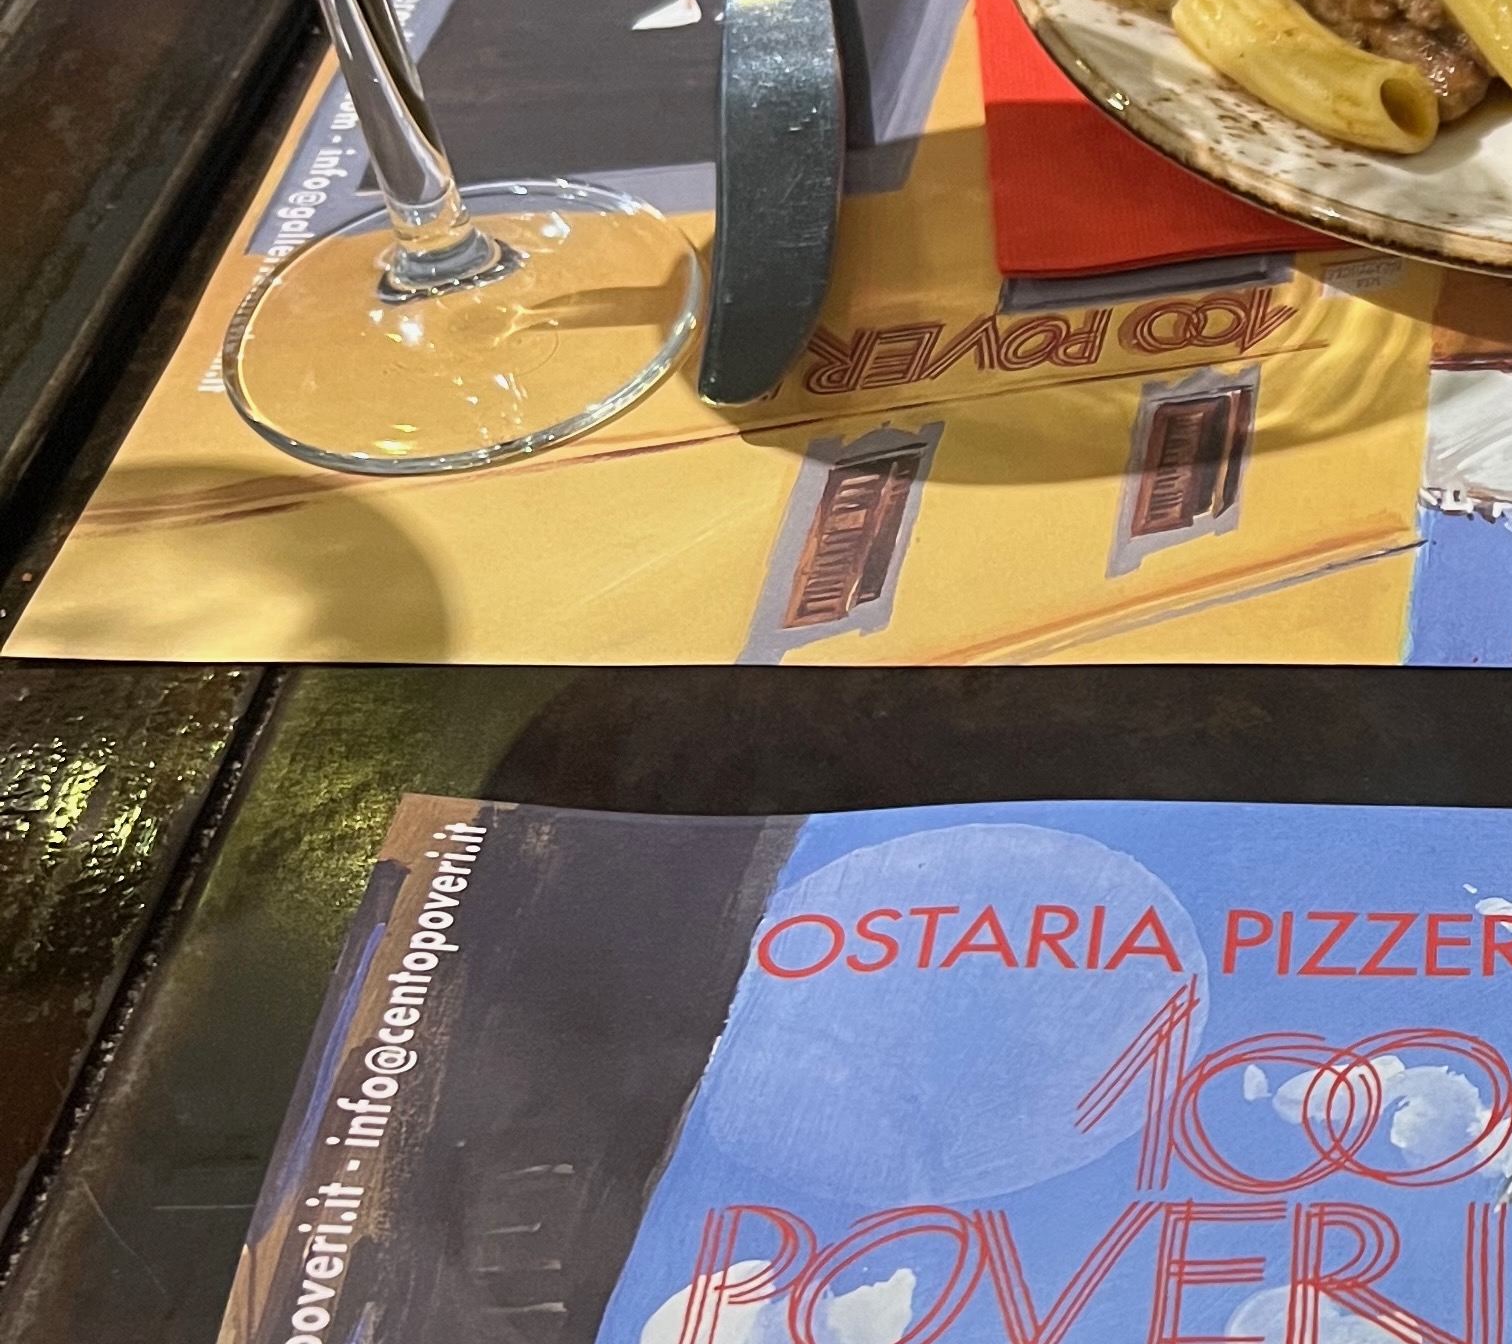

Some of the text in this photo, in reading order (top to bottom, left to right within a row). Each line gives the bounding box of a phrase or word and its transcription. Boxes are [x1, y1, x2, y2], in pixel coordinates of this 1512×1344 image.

[766, 306, 1115, 402] POVER
[326, 822, 487, 1147] info@centopoveri.it
[756, 904, 1184, 979] OSTARIA
